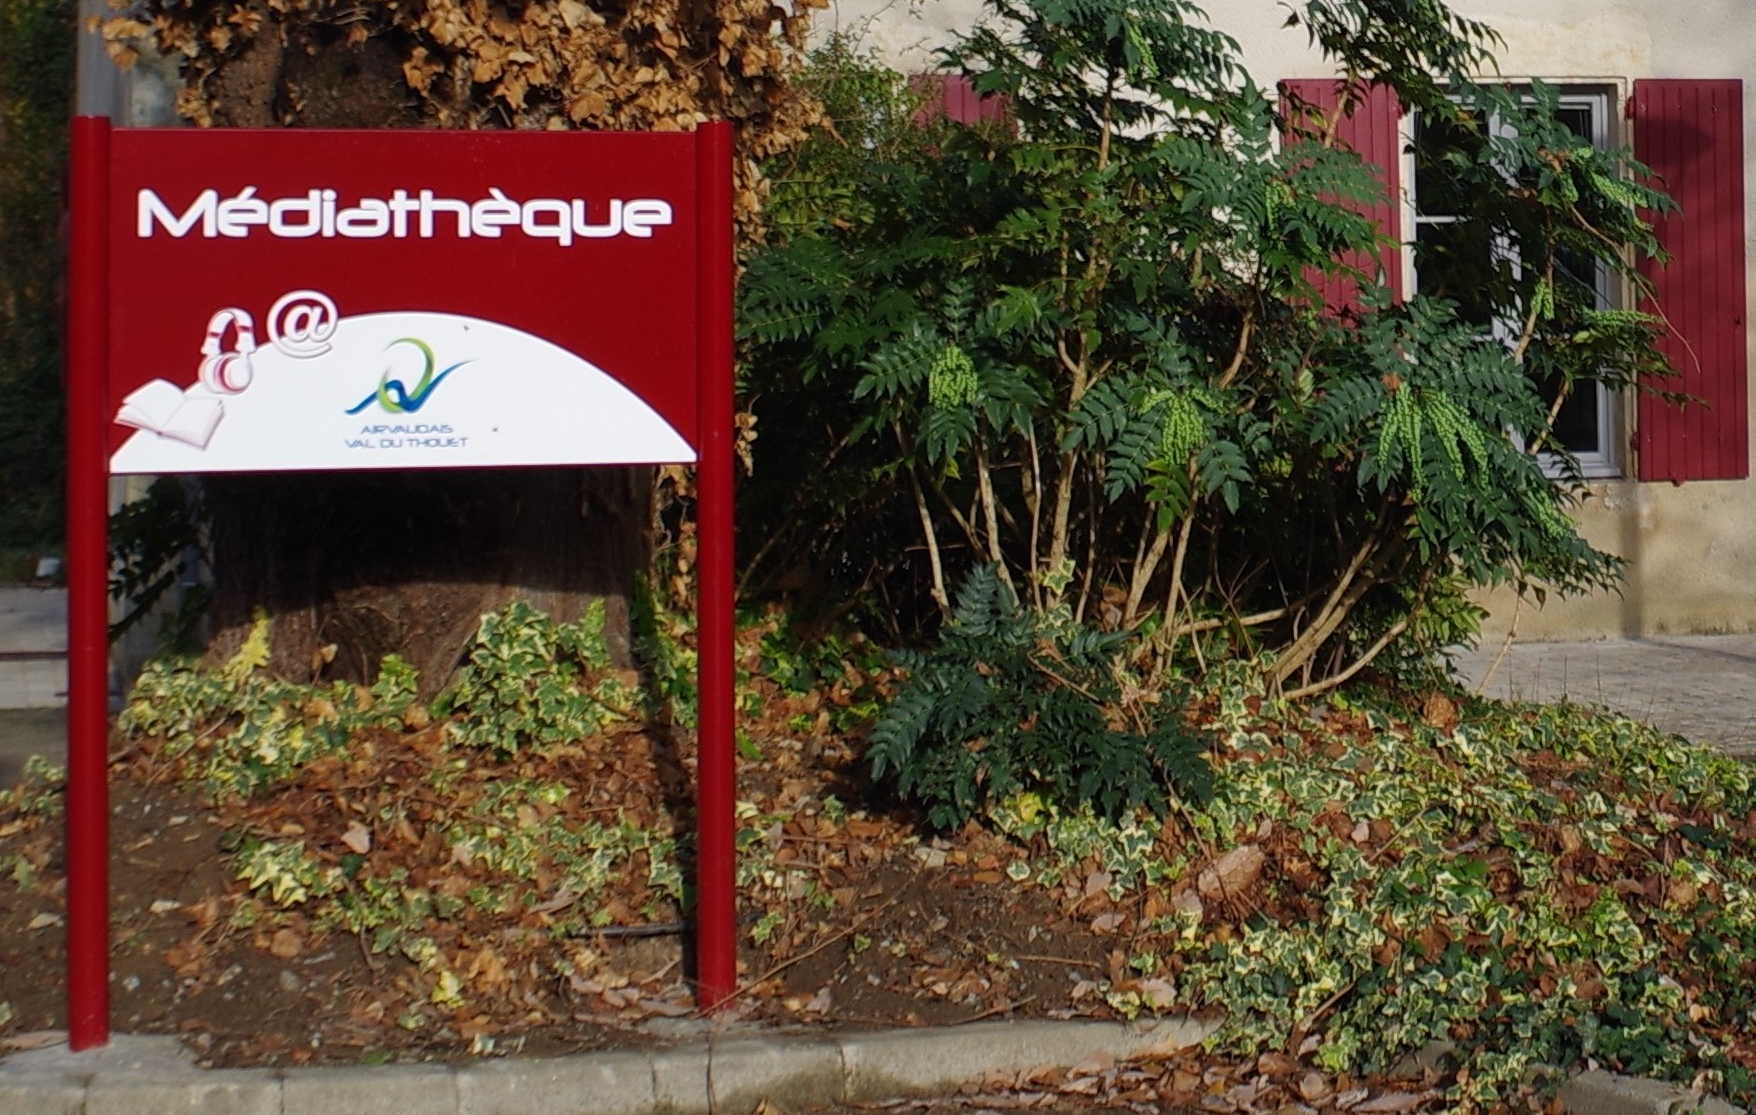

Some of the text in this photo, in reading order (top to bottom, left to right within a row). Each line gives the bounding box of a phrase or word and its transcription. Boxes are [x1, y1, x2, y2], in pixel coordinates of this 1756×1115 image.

[137, 186, 673, 247] Médiathèque
[361, 424, 454, 435] AIRVAUDAIS
[345, 437, 469, 449] VAL DU THOUET
